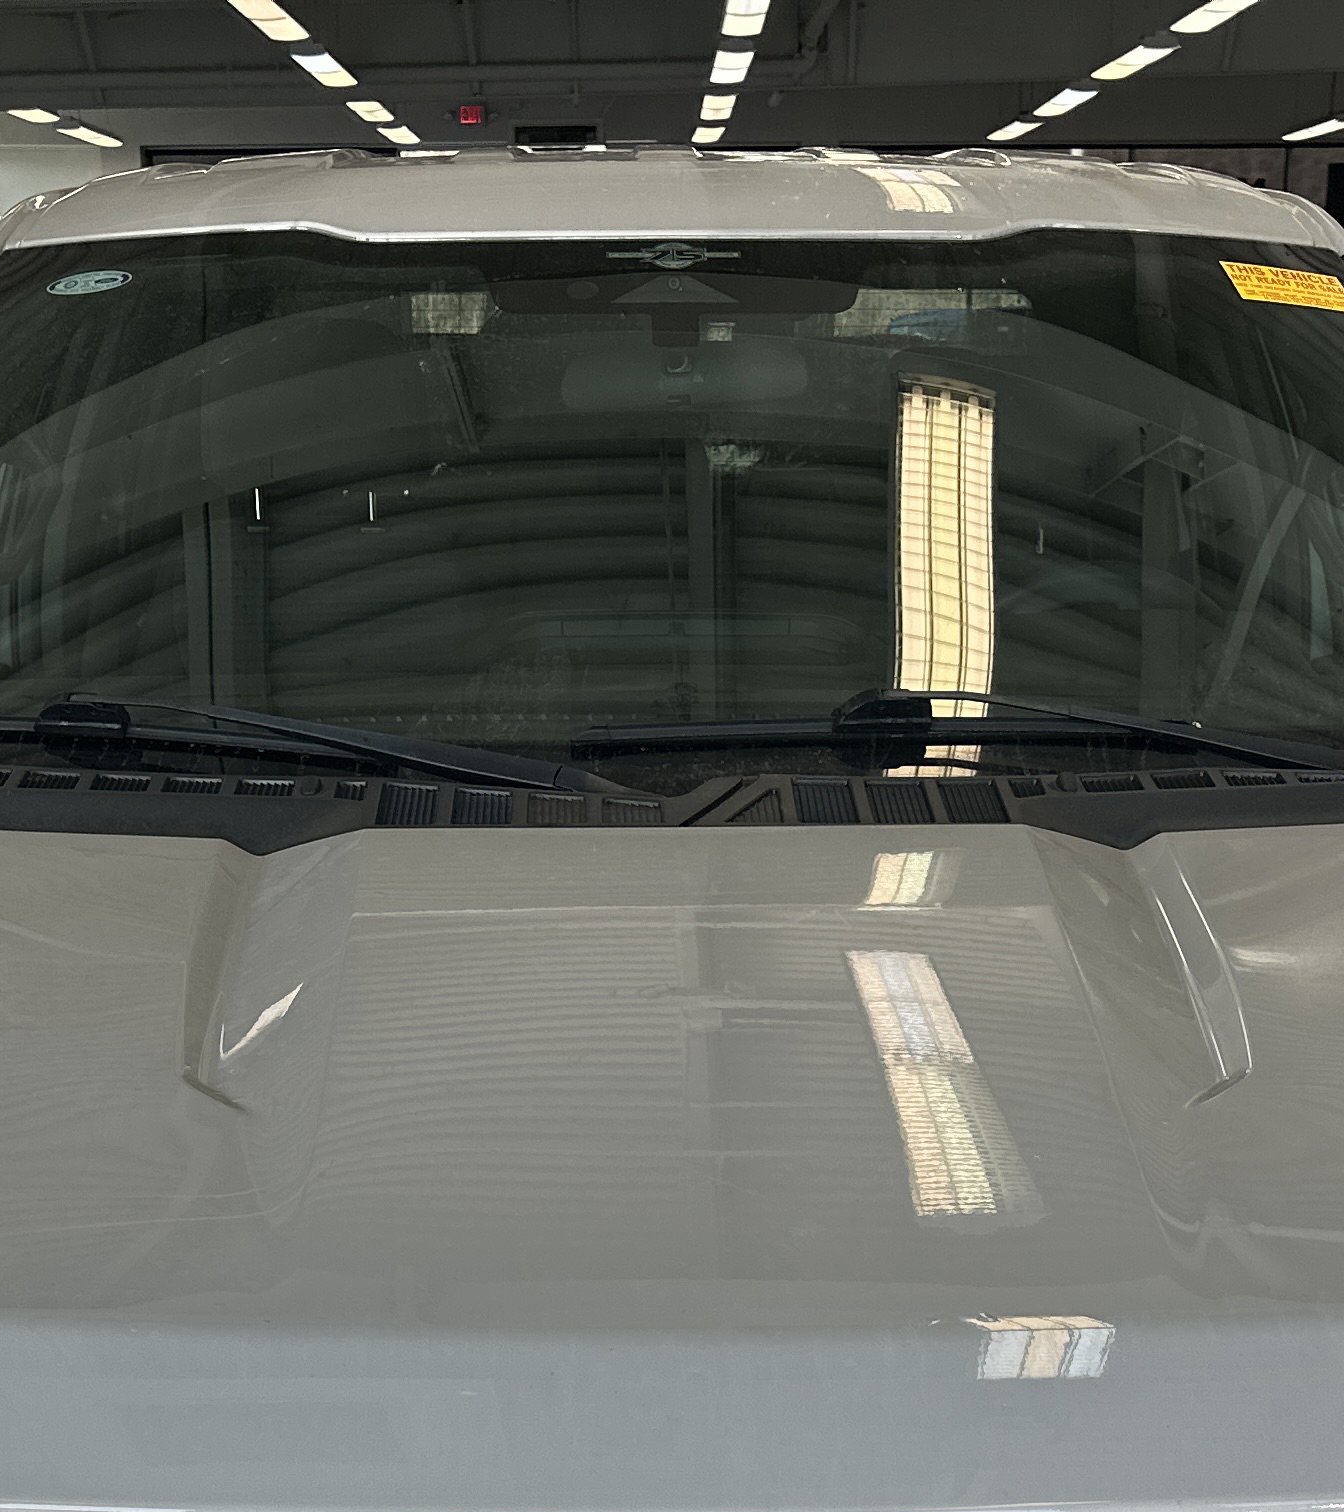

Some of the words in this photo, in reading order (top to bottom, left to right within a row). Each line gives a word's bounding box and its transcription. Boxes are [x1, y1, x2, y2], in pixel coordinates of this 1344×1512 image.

[1226, 264, 1266, 275] THIS
[1268, 268, 1339, 286] VEHICLE
[1231, 273, 1253, 283] NOT
[1256, 277, 1292, 287] READY
[1294, 281, 1317, 291] FOR
